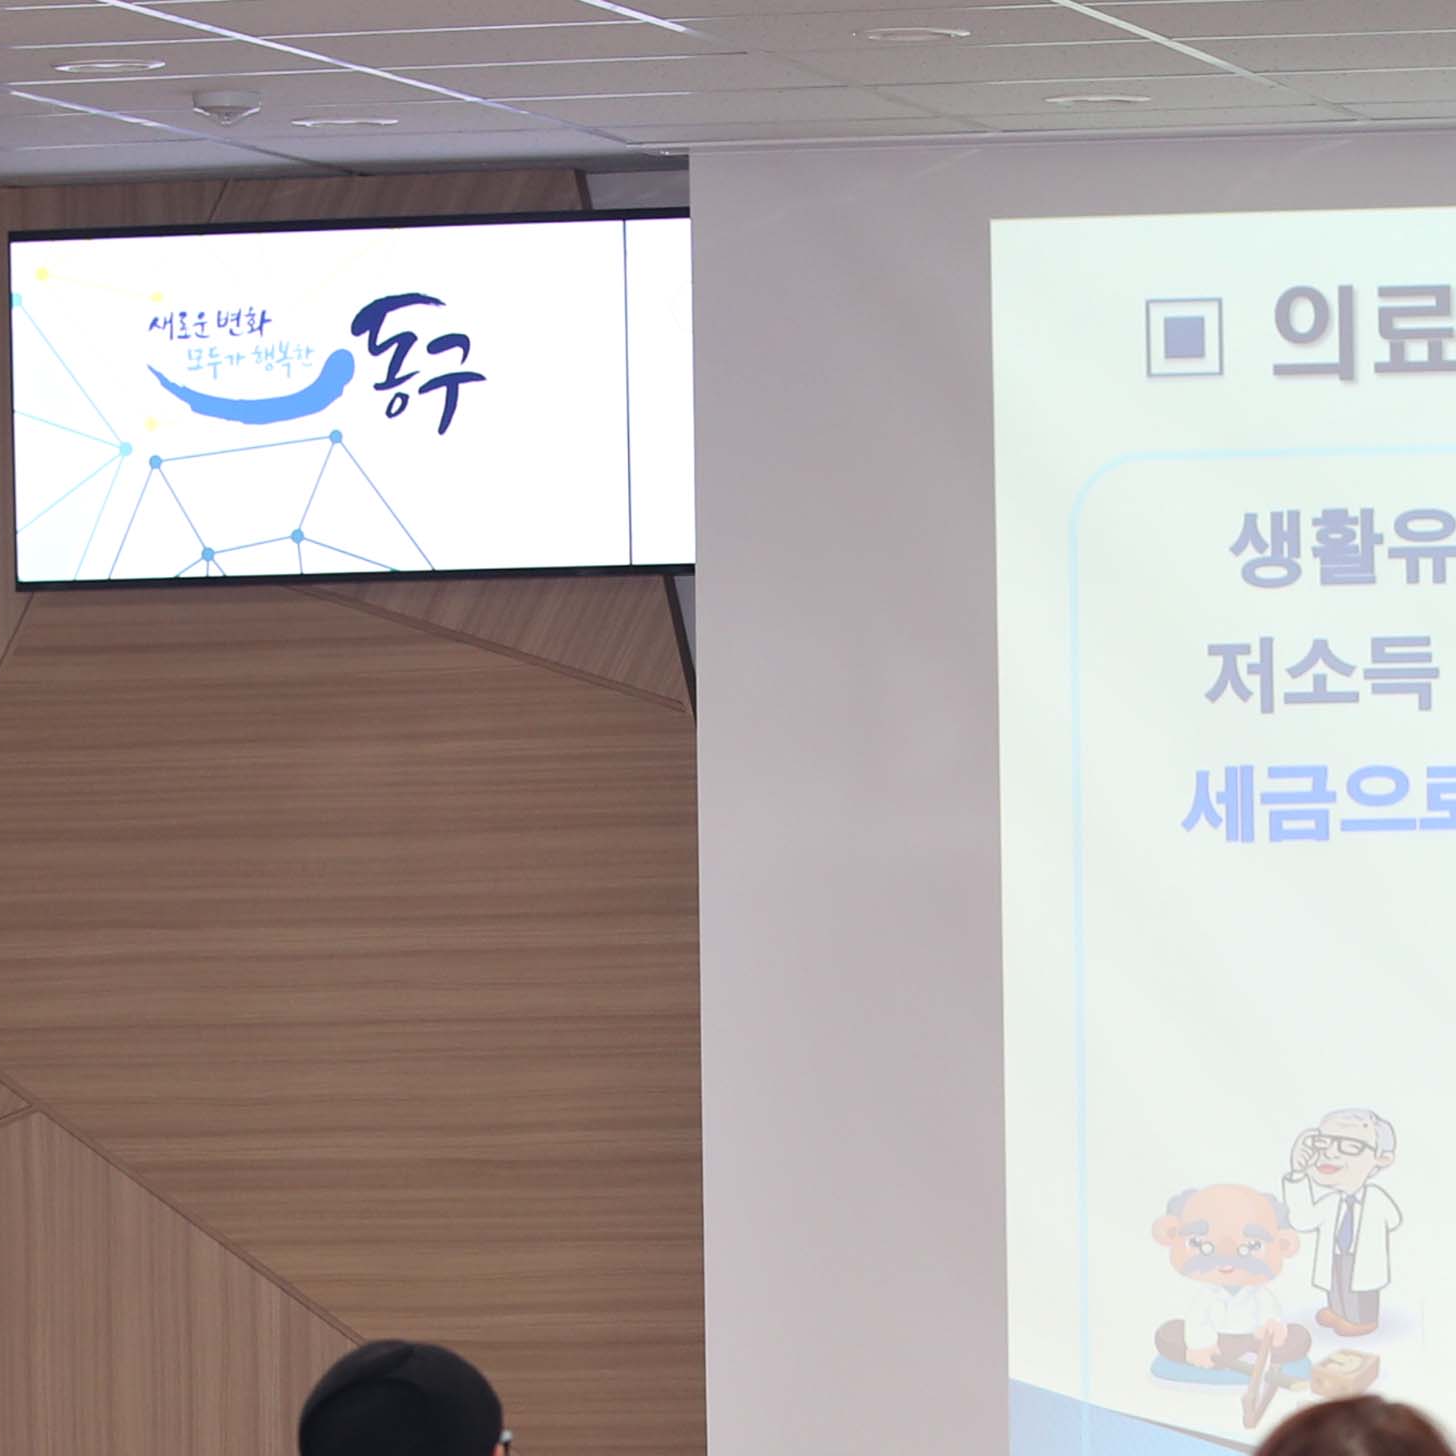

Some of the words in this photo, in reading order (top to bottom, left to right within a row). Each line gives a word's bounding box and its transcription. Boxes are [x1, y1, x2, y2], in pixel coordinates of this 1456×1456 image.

[148, 310, 211, 341] 새로운
[216, 305, 273, 338] 변화
[186, 345, 246, 381] 모두가
[250, 339, 316, 379] 행복한
[350, 291, 488, 436] 동구
[1204, 635, 1441, 715] 저소득
